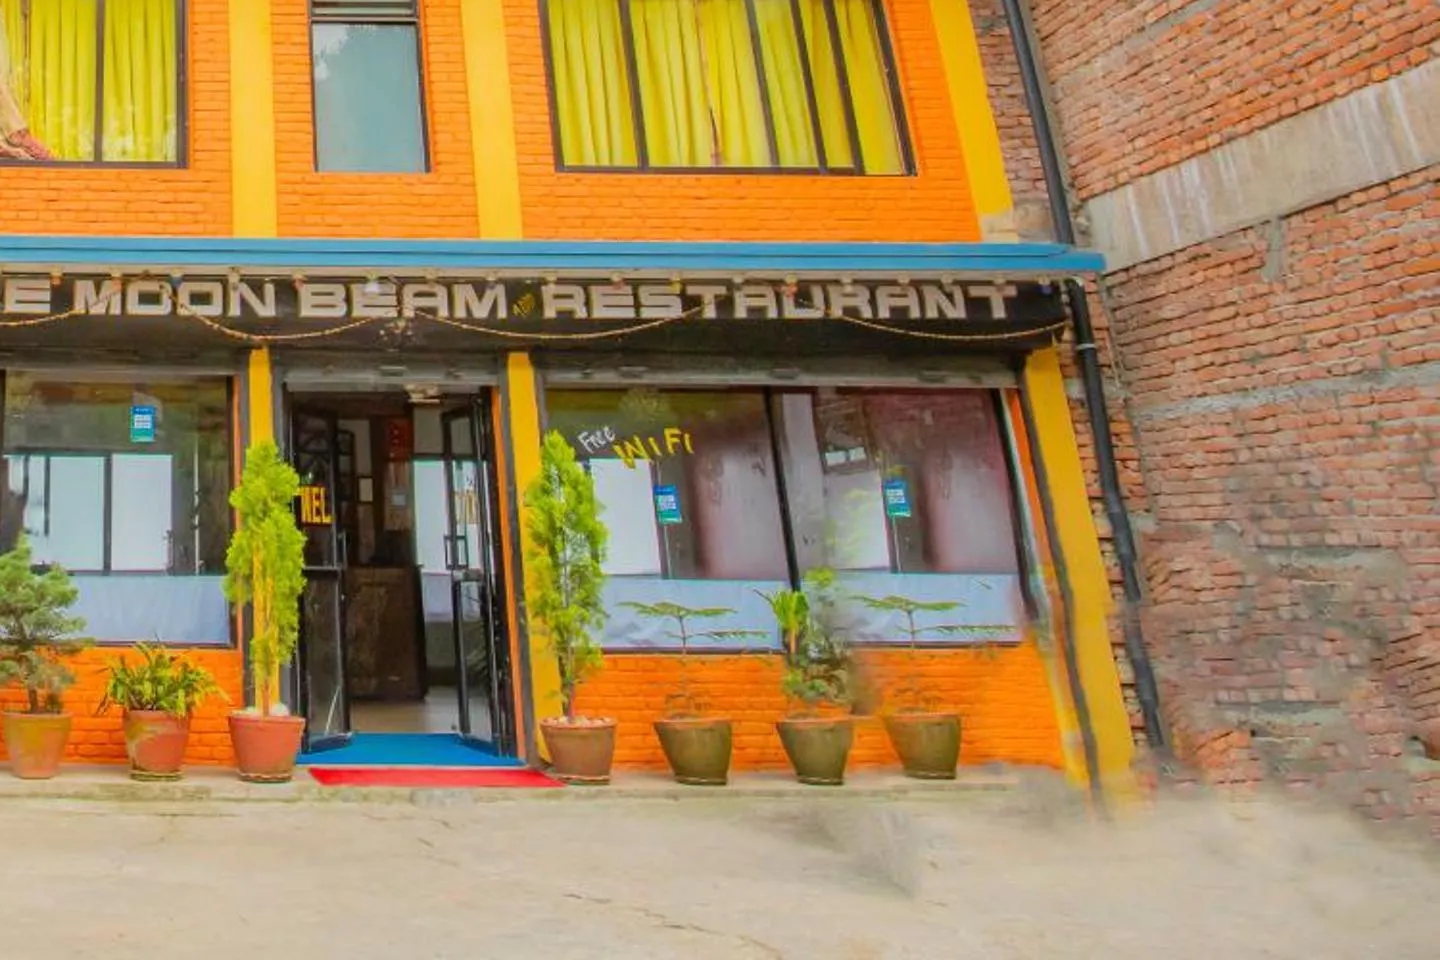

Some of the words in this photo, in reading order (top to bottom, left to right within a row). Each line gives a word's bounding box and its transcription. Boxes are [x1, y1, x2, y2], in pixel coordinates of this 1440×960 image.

[73, 279, 277, 317] MOON
[297, 283, 508, 319] BEAM
[541, 283, 1019, 319] RESTAURANT
